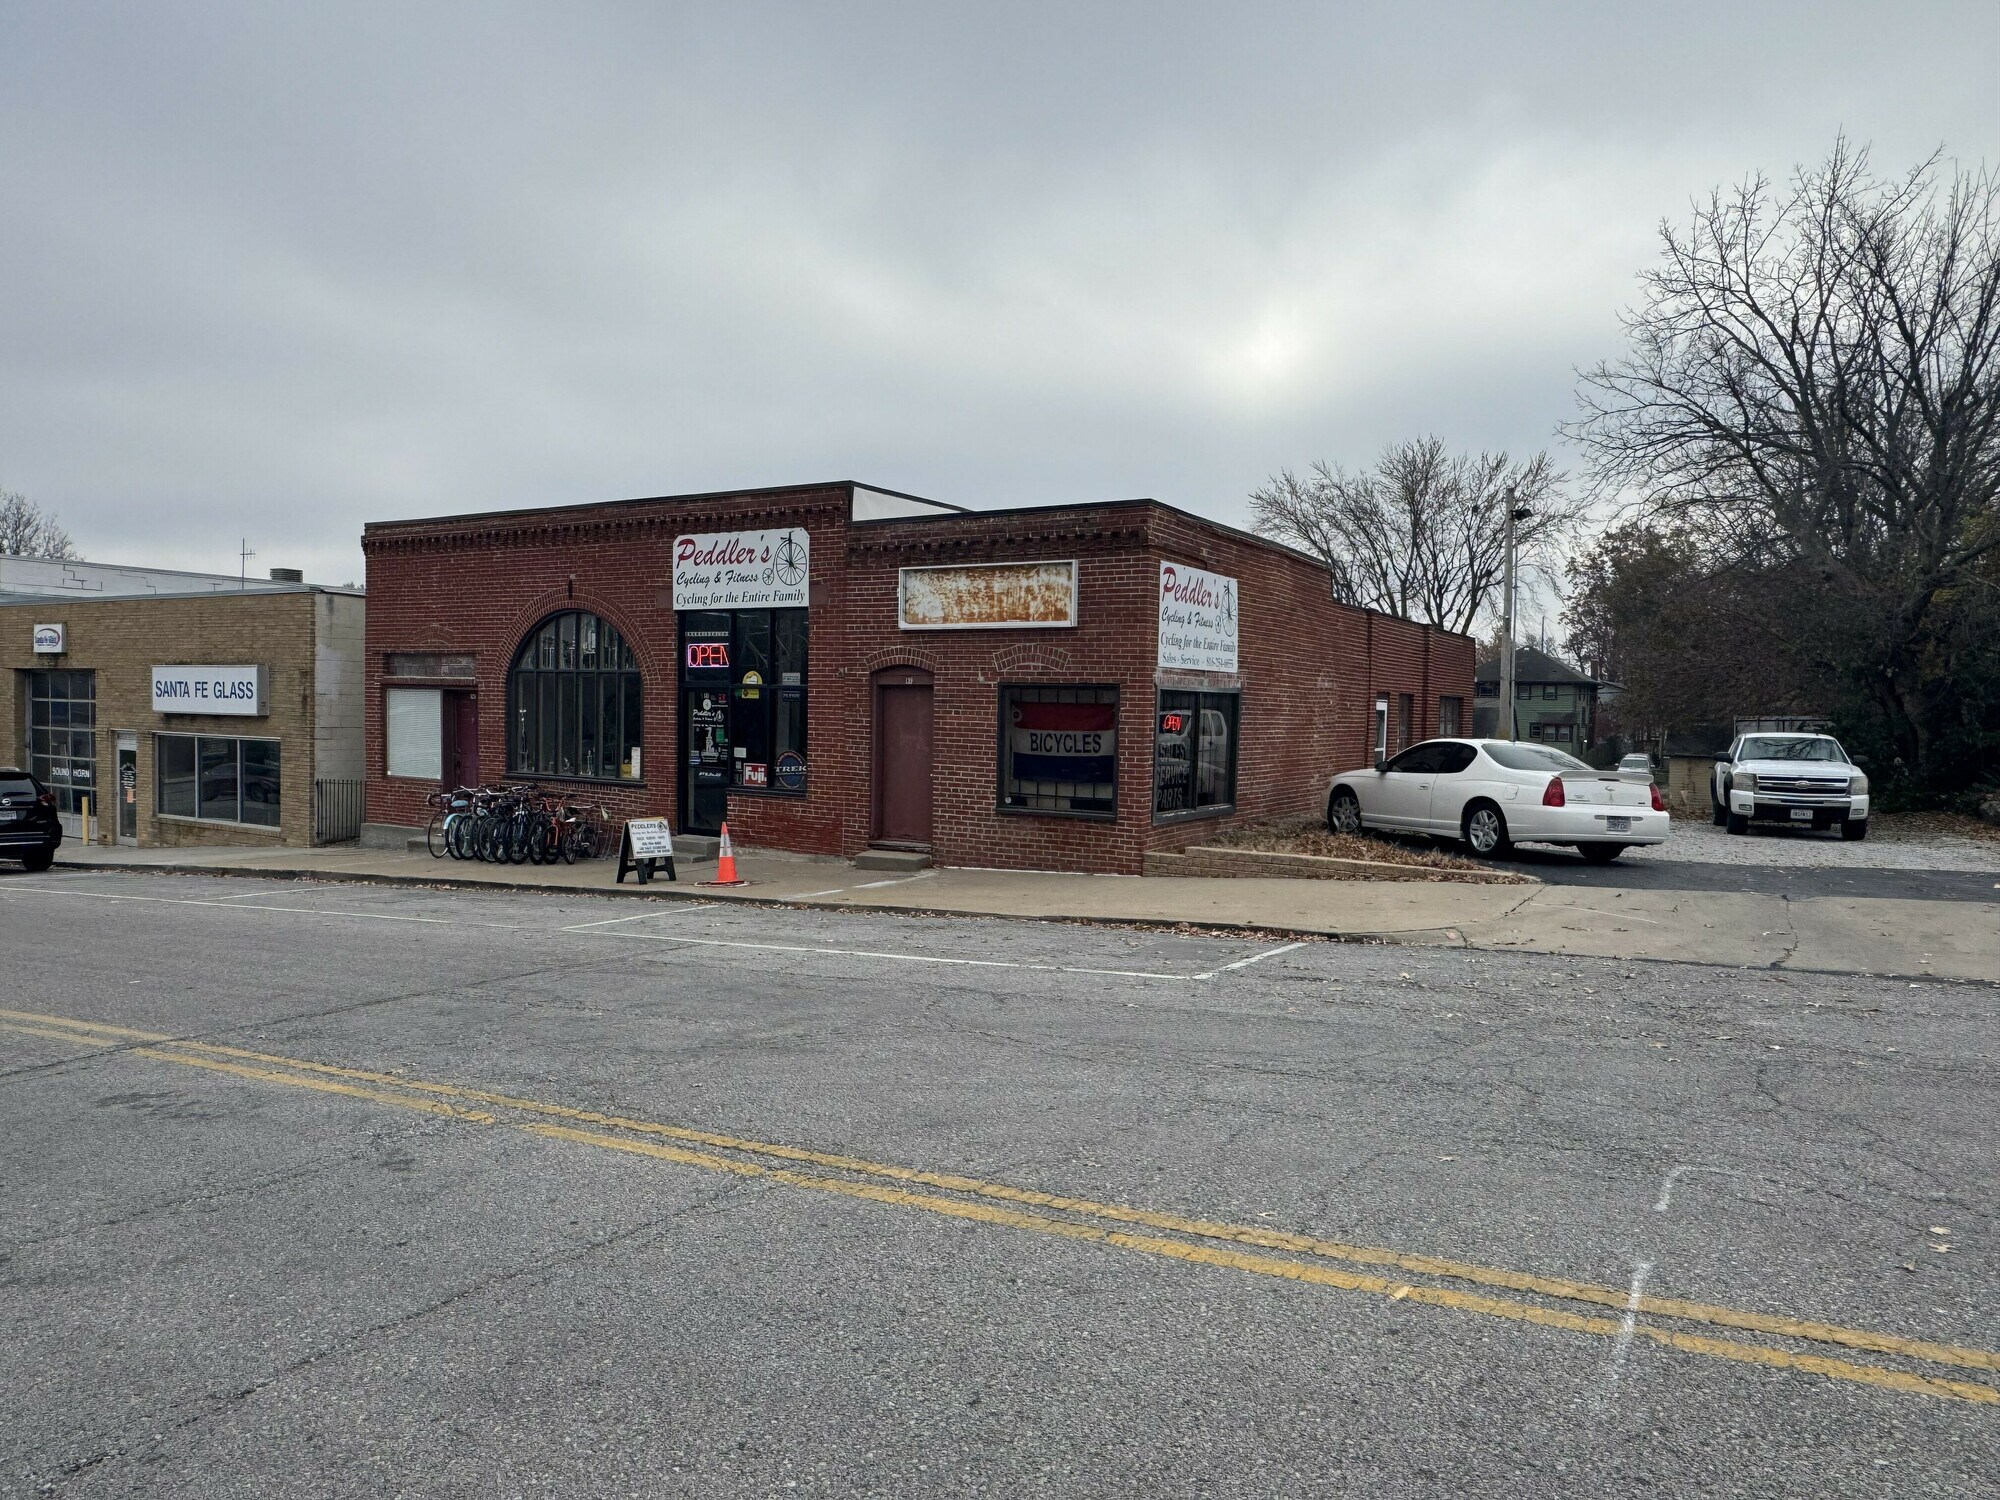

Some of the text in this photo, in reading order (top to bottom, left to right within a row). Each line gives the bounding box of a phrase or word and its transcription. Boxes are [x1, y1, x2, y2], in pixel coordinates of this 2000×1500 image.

[676, 534, 772, 569] Peddler's
[676, 570, 759, 588] Cycling & Fitness
[1162, 566, 1220, 609] Peddler's
[676, 589, 805, 607] Cycling for the Entire Family
[1161, 606, 1184, 629] Cycling
[1160, 632, 1182, 650] Cycling
[1182, 635, 1191, 650] for
[688, 644, 730, 667] OPEN
[155, 680, 254, 699] SANTA FE GLASS
[1163, 713, 1182, 731] OPEN
[1030, 733, 1102, 753] BICYCLES
[52, 766, 90, 778] SOUND HORN
[1157, 763, 1189, 786] SERVICE
[1157, 787, 1183, 808] PARTS
